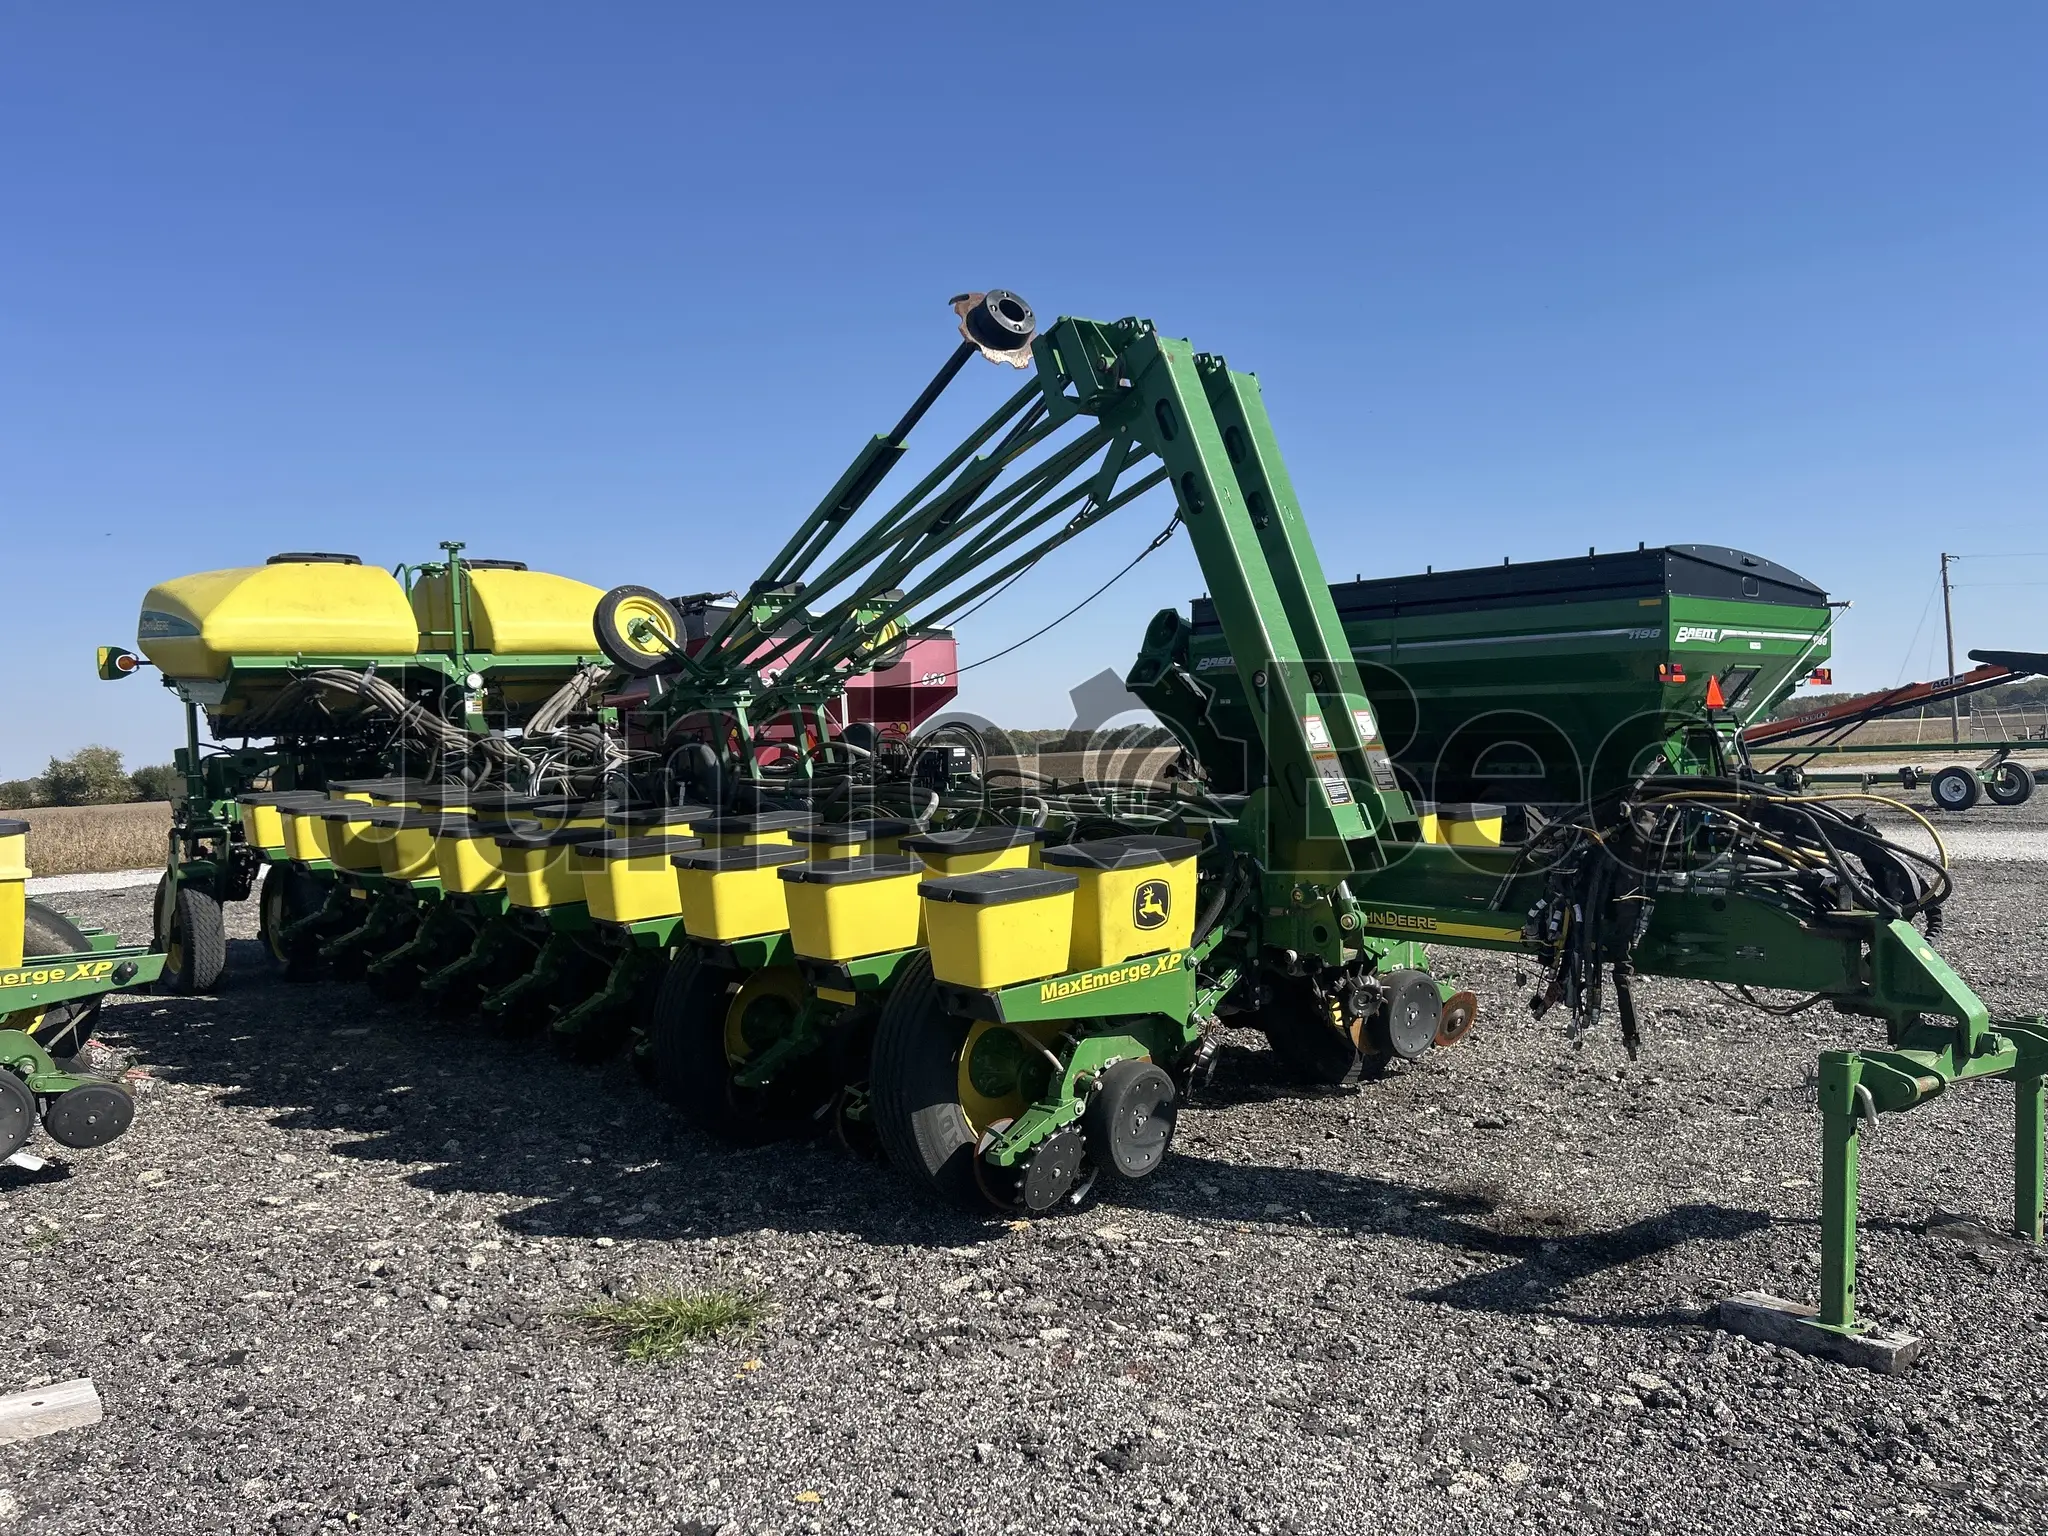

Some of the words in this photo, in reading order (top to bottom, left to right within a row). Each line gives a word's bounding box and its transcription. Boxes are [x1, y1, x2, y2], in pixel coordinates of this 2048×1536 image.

[1628, 628, 1661, 640] 1198
[1675, 626, 1717, 643] BRENT
[1195, 656, 1236, 671] BREN
[1385, 911, 1437, 930] DEERE
[0, 968, 67, 985] erge
[65, 961, 114, 982] XP
[1041, 963, 1151, 1002] MaxEmerge
[1150, 953, 1182, 977] XP
